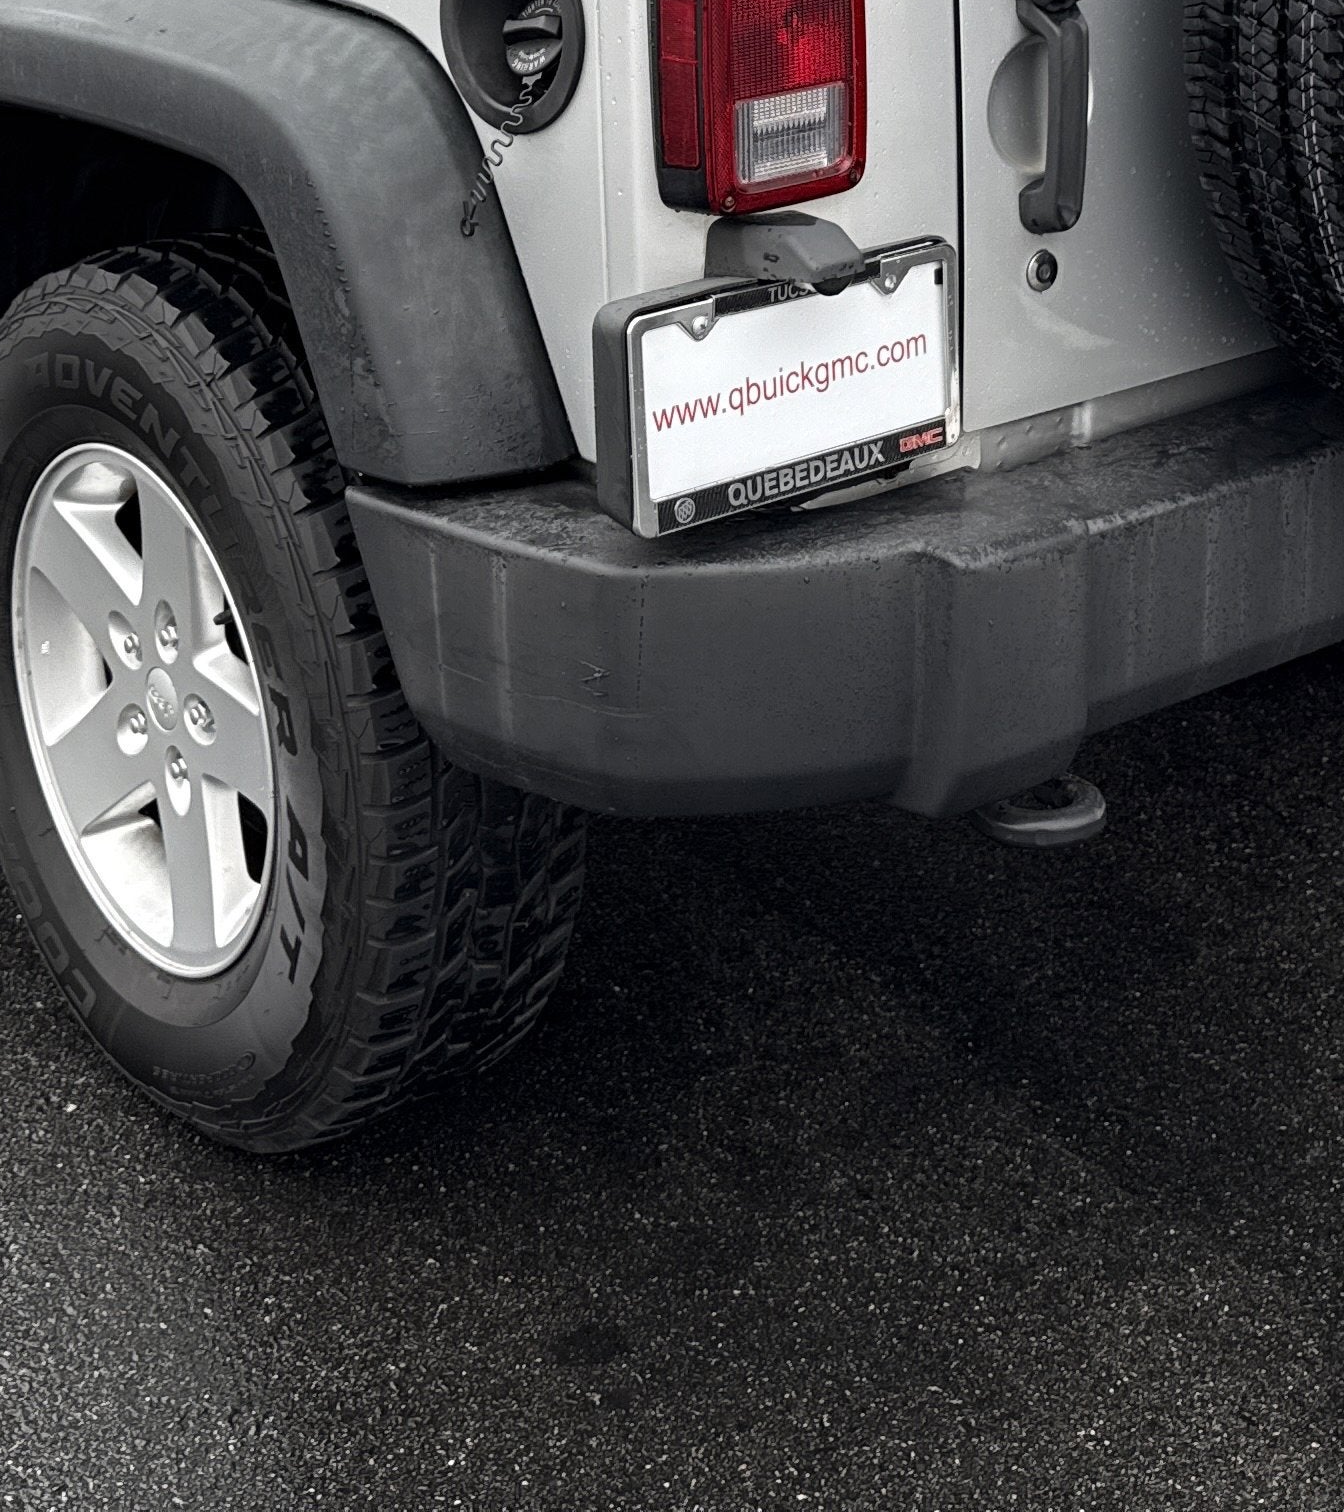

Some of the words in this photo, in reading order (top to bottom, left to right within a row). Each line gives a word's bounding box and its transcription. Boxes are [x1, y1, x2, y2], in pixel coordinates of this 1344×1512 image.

[652, 333, 928, 433] www.qbuickgmc.com
[727, 440, 886, 507] QUEBEDEAUX
[899, 427, 944, 453] GMC
